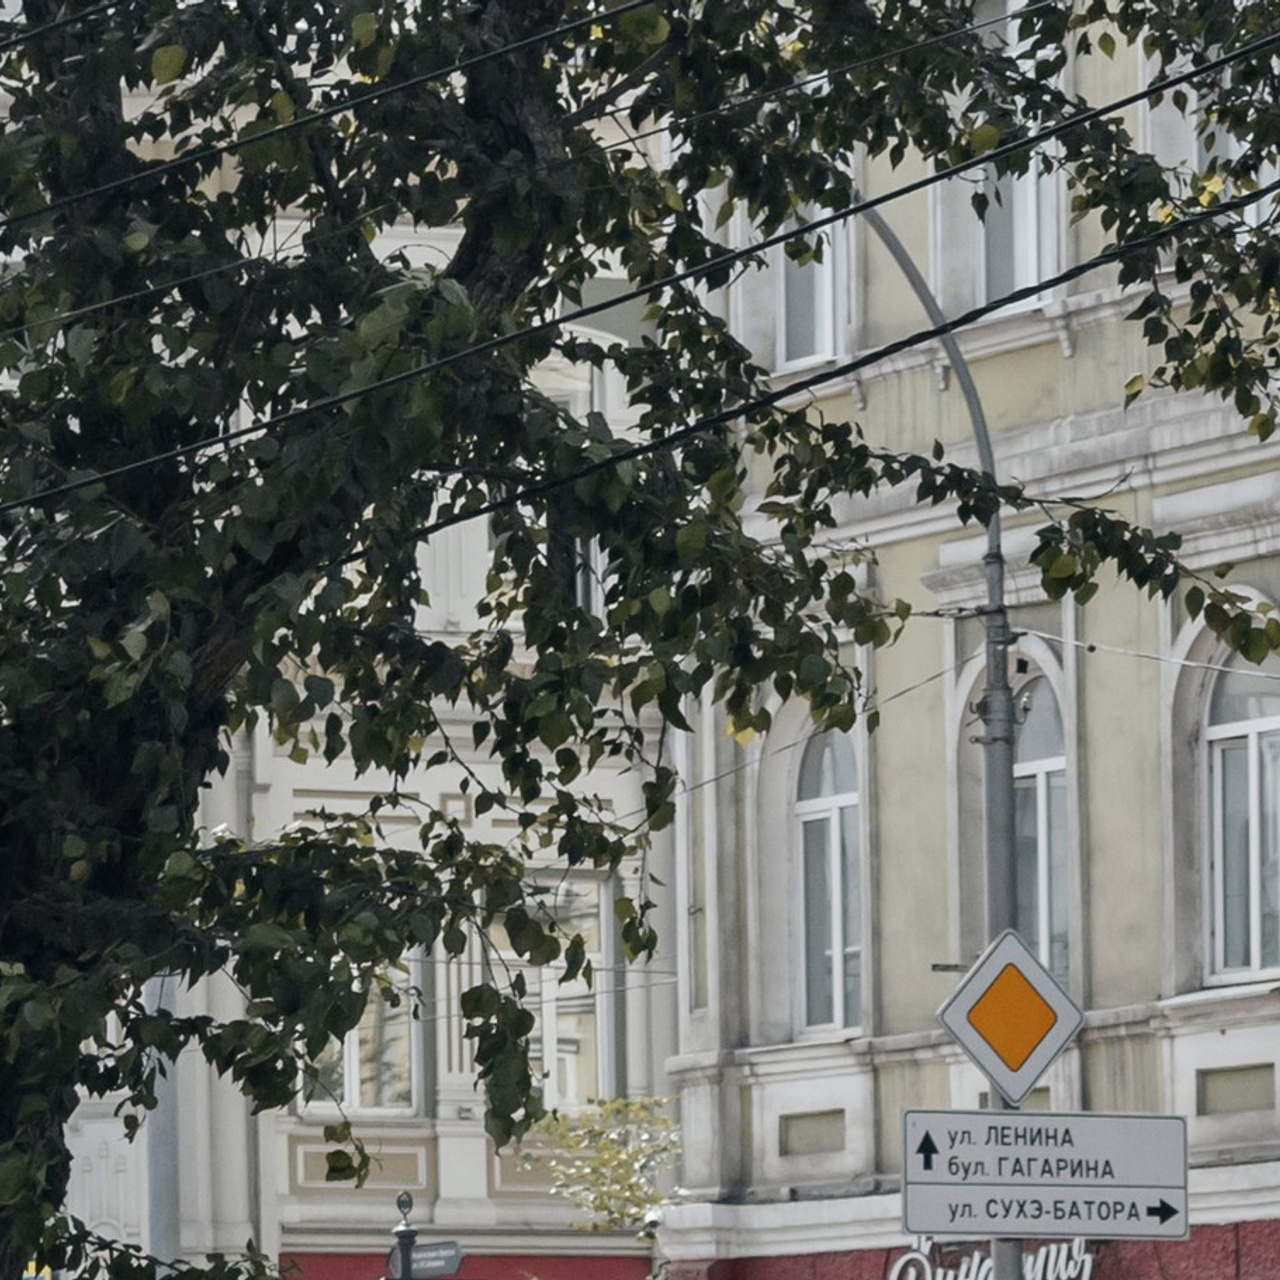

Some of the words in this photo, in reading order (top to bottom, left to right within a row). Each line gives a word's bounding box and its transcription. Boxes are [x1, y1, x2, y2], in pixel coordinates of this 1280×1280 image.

[948, 1130, 977, 1149] ул.
[985, 1126, 1074, 1148] ЛЕНИНА
[947, 1156, 989, 1180] бул.
[998, 1157, 1115, 1179] ГАГАРИНА
[948, 1203, 977, 1223] ул.
[985, 1199, 1141, 1222] СУХЭ-БАТОРА
